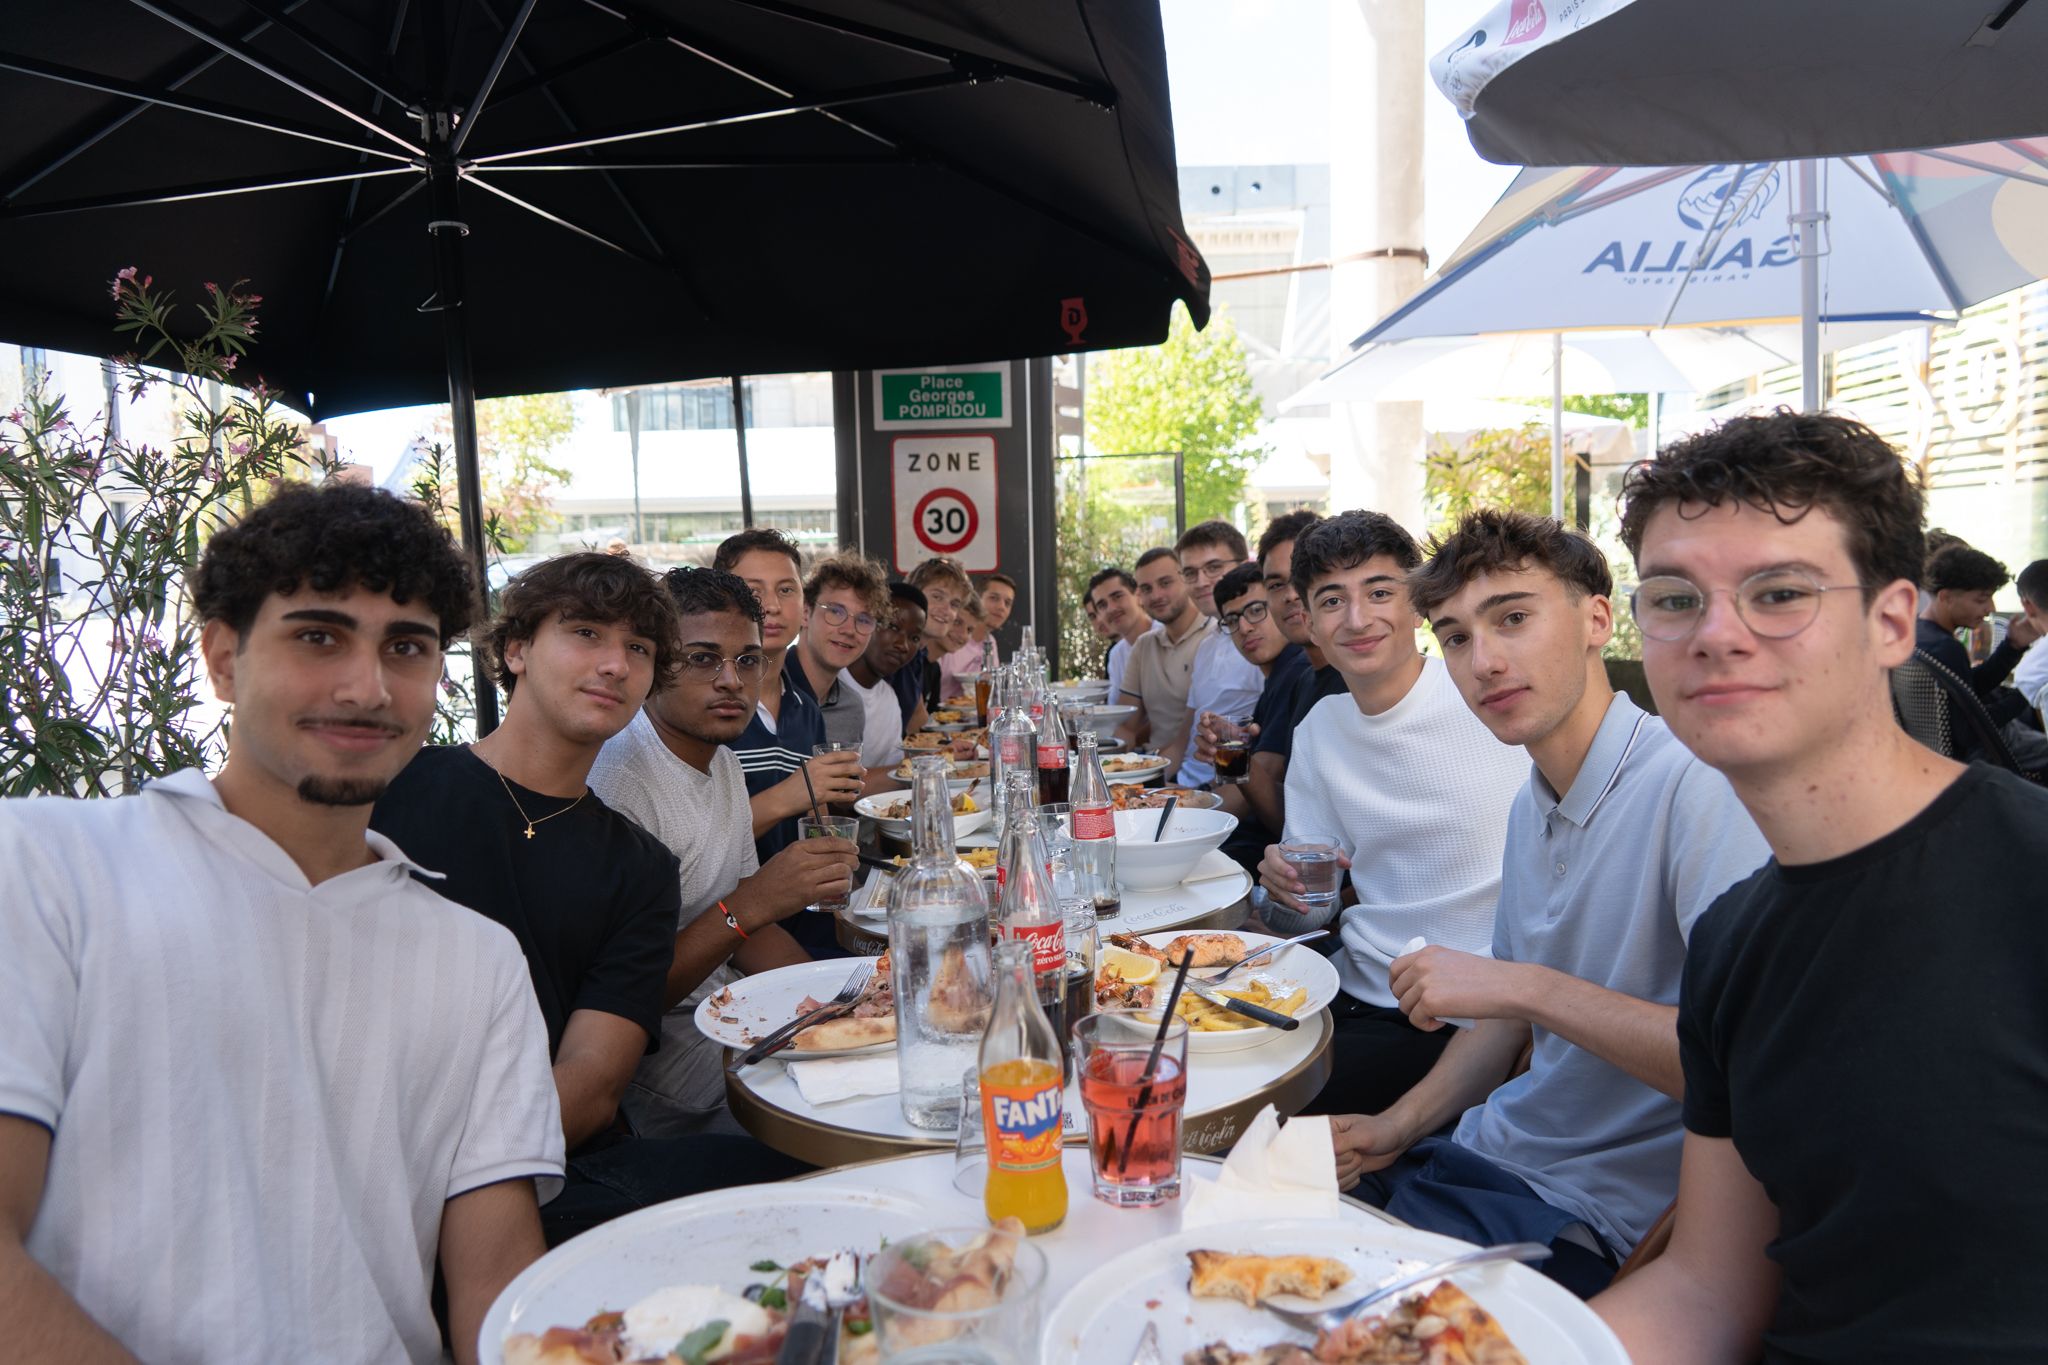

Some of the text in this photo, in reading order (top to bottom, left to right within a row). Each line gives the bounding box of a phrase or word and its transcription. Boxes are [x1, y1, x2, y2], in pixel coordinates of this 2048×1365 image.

[921, 376, 963, 389] Place
[909, 389, 975, 405] Georges
[899, 403, 986, 418] POMPIDOU
[908, 452, 981, 472] ZONE
[927, 508, 966, 534] 30
